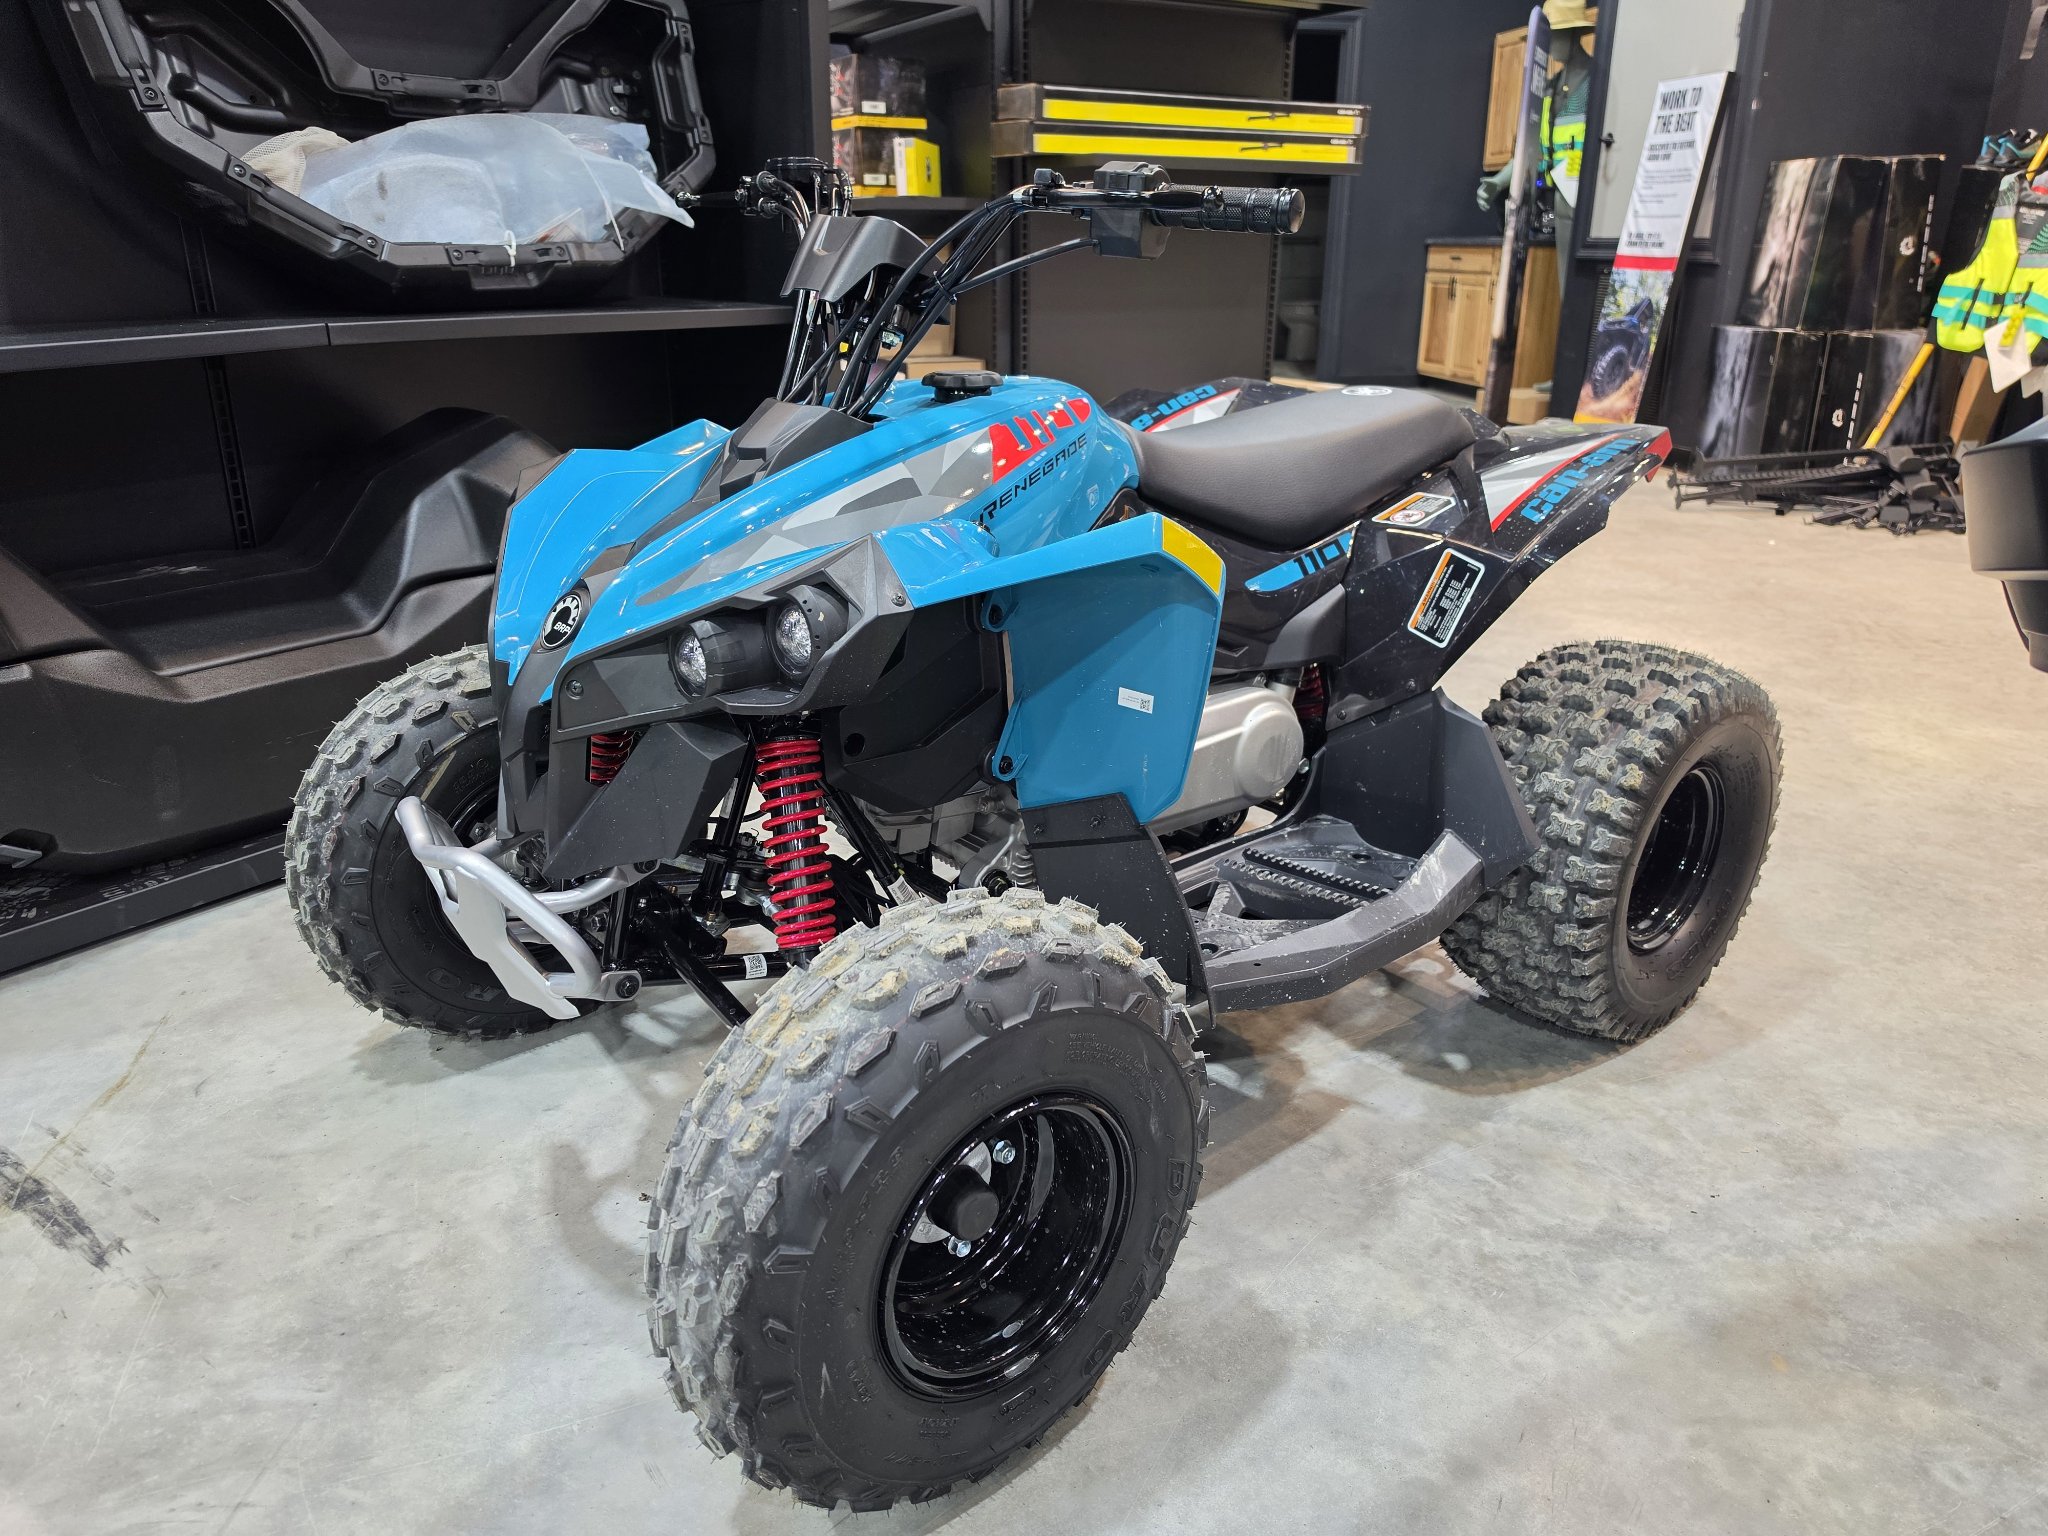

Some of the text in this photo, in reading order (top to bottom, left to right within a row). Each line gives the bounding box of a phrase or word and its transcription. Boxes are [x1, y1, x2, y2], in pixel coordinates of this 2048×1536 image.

[1660, 86, 1702, 110] WORK TO
[1654, 111, 1697, 134] THE BEAT
[1130, 384, 1217, 431] can-a
[979, 433, 1087, 524] RENEGADE
[1293, 538, 1347, 578] 110
[553, 621, 571, 633] BRP
